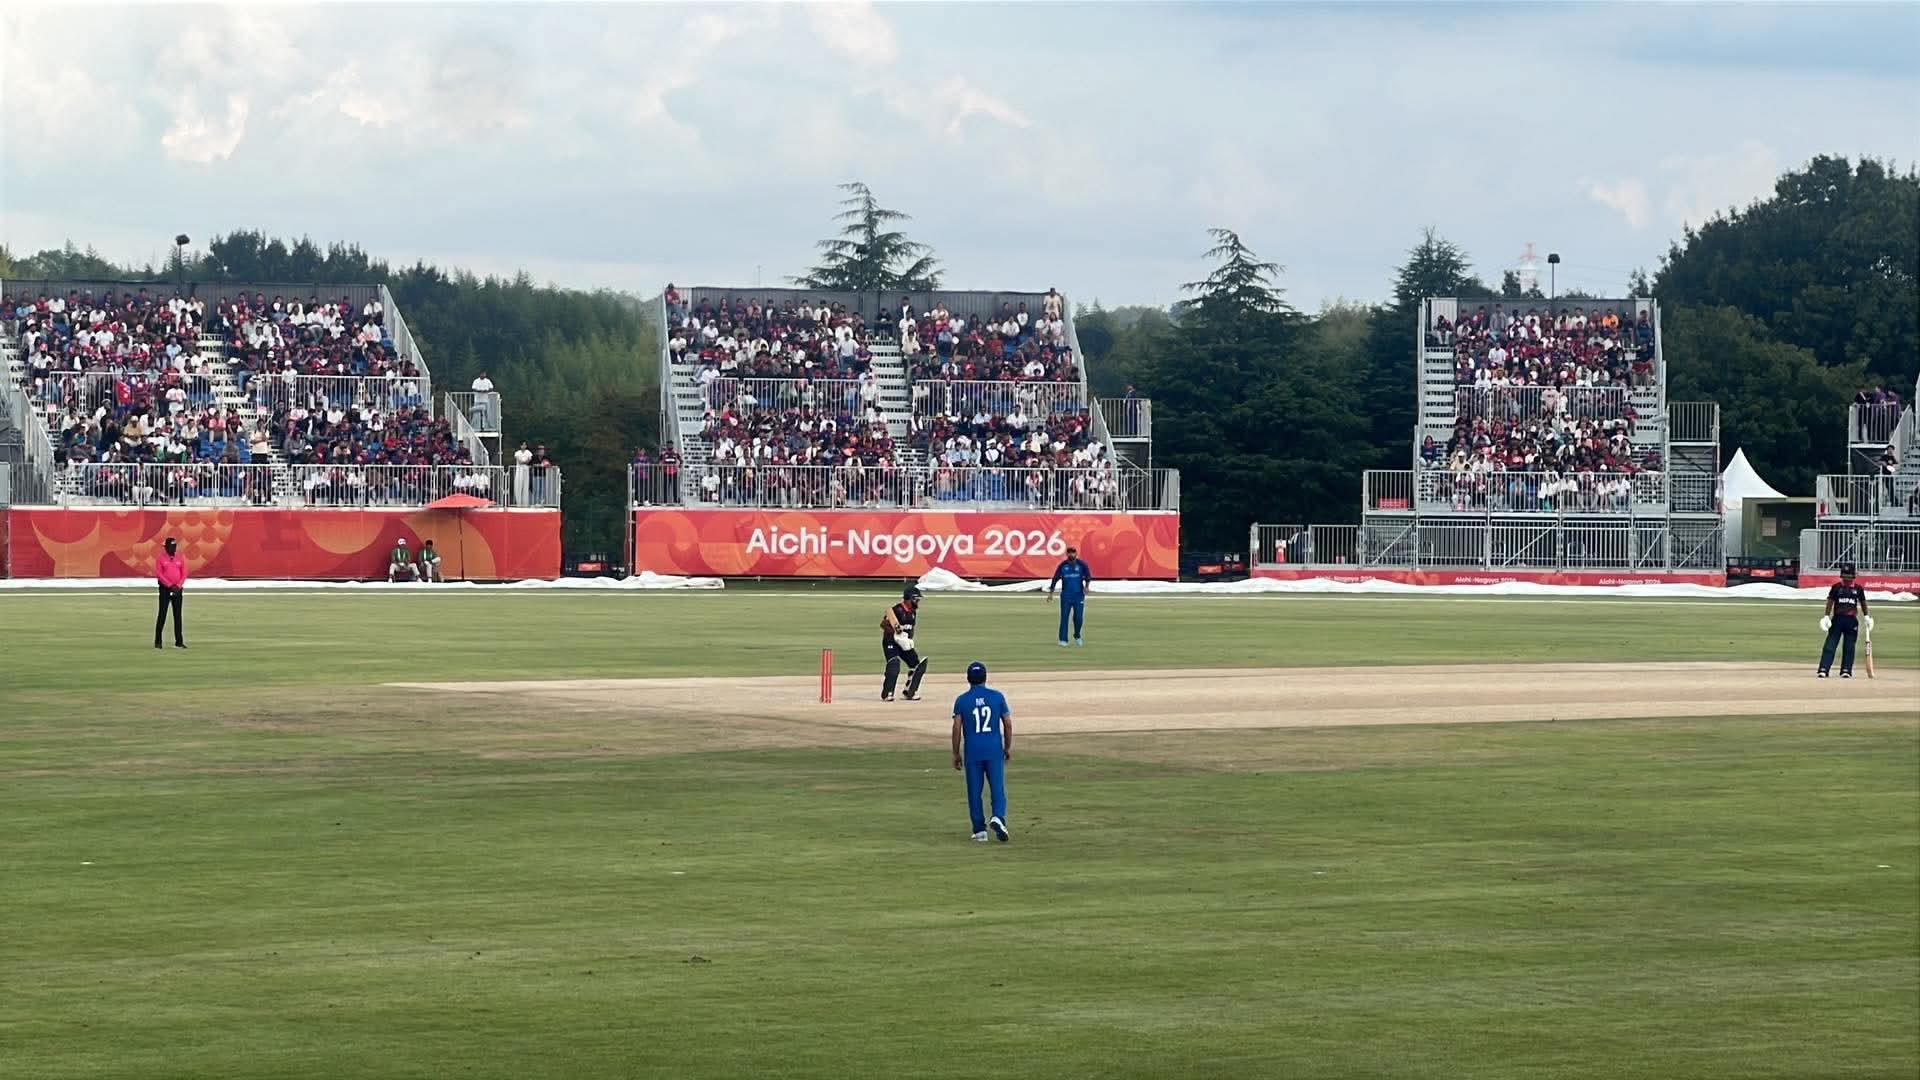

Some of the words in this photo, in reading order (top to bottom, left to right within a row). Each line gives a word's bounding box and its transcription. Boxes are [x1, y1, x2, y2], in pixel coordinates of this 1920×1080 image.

[746, 527, 974, 563] Aichi-Nagoya
[984, 529, 1067, 556] 2026
[972, 706, 992, 733] 12
